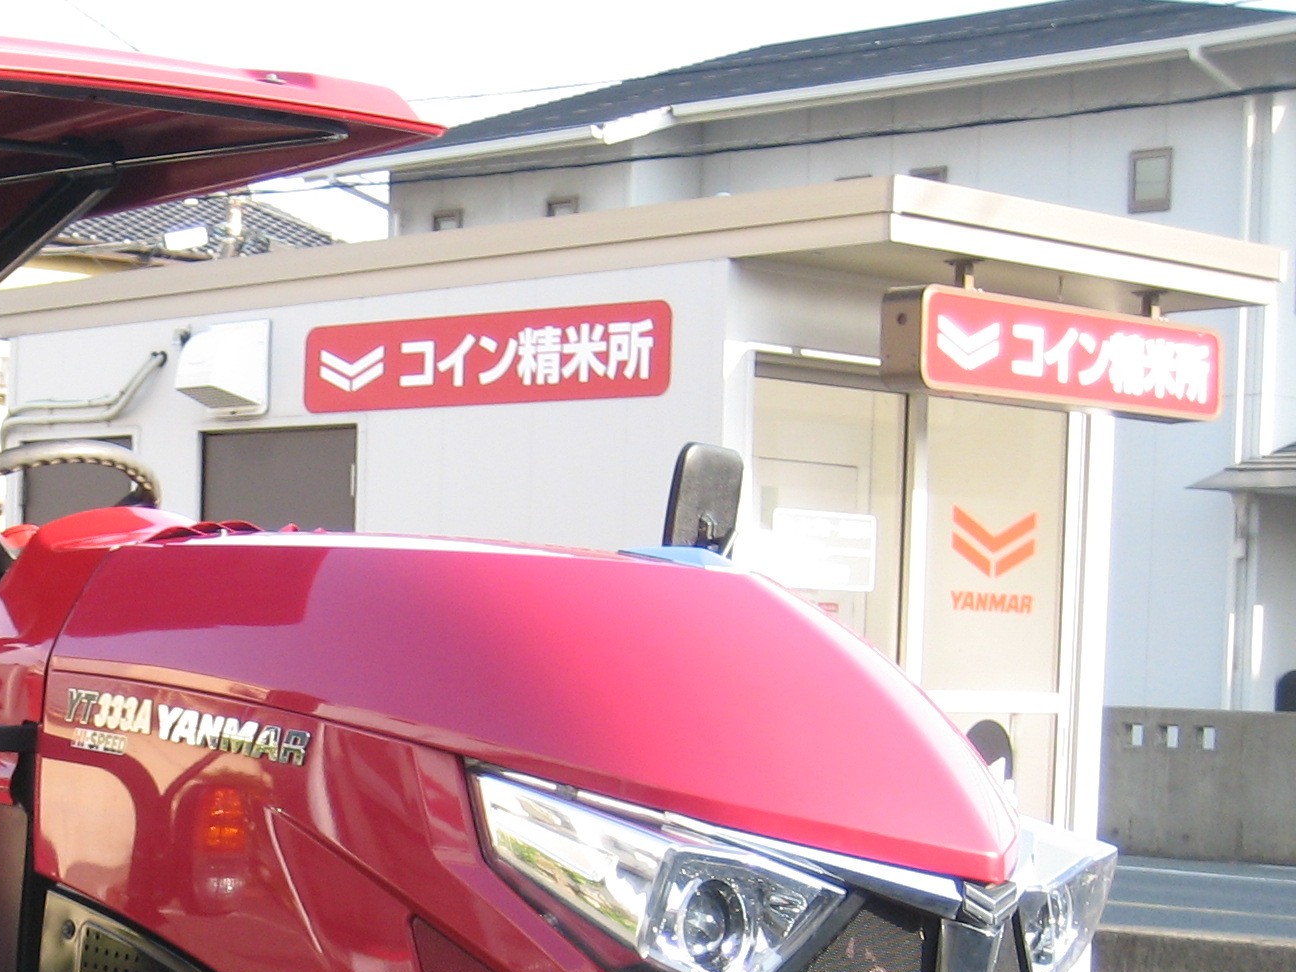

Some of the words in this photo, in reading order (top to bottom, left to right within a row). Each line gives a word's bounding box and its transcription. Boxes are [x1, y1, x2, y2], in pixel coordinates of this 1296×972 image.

[399, 318, 654, 388] コイン精米所
[950, 590, 1033, 615] YANMAR
[65, 687, 154, 735] YT333A
[157, 703, 311, 767] YANMAR
